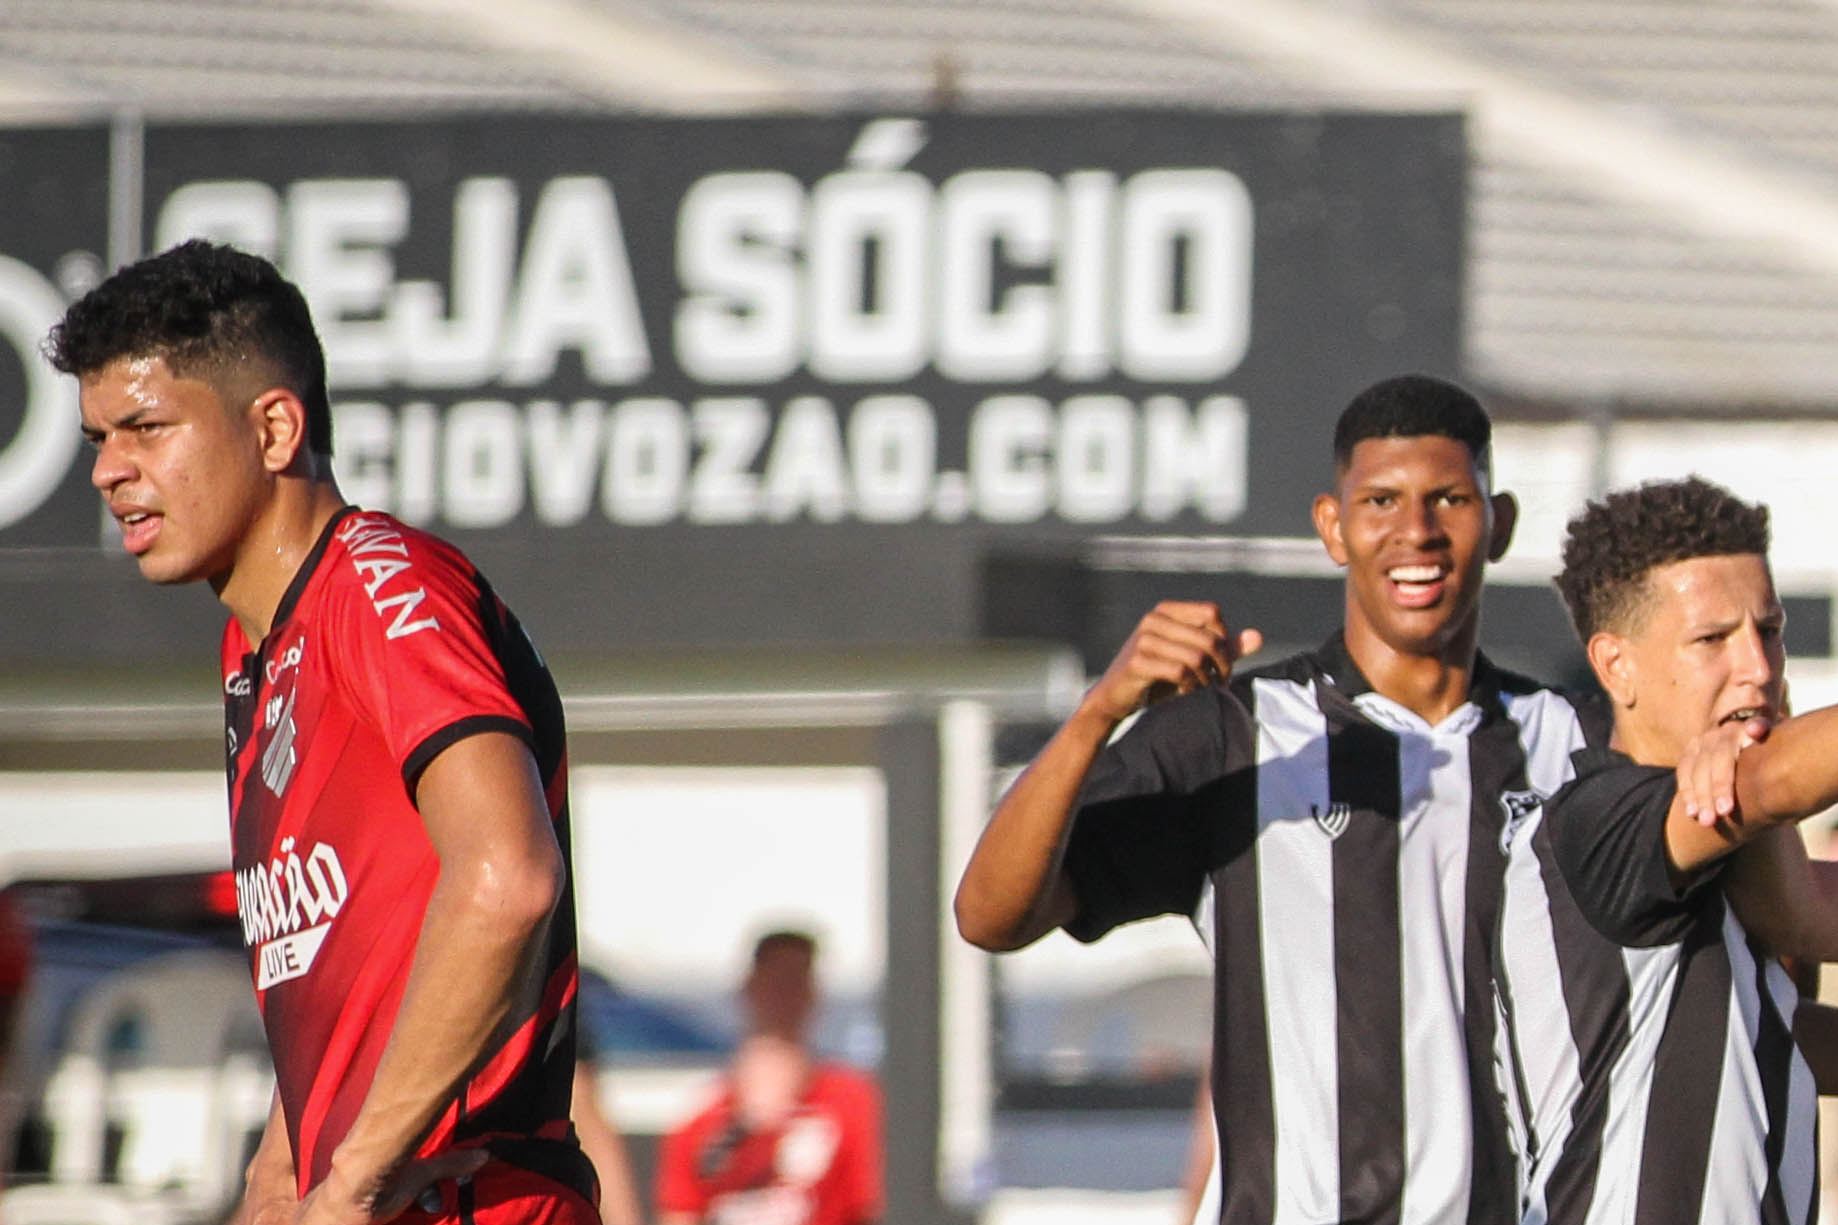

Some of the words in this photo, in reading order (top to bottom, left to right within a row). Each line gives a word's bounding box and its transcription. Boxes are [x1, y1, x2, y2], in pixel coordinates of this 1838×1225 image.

[674, 117, 1255, 384] SÓCIO
[331, 393, 1250, 528] CIOVOZAO.COM
[265, 942, 300, 979] LIVE
